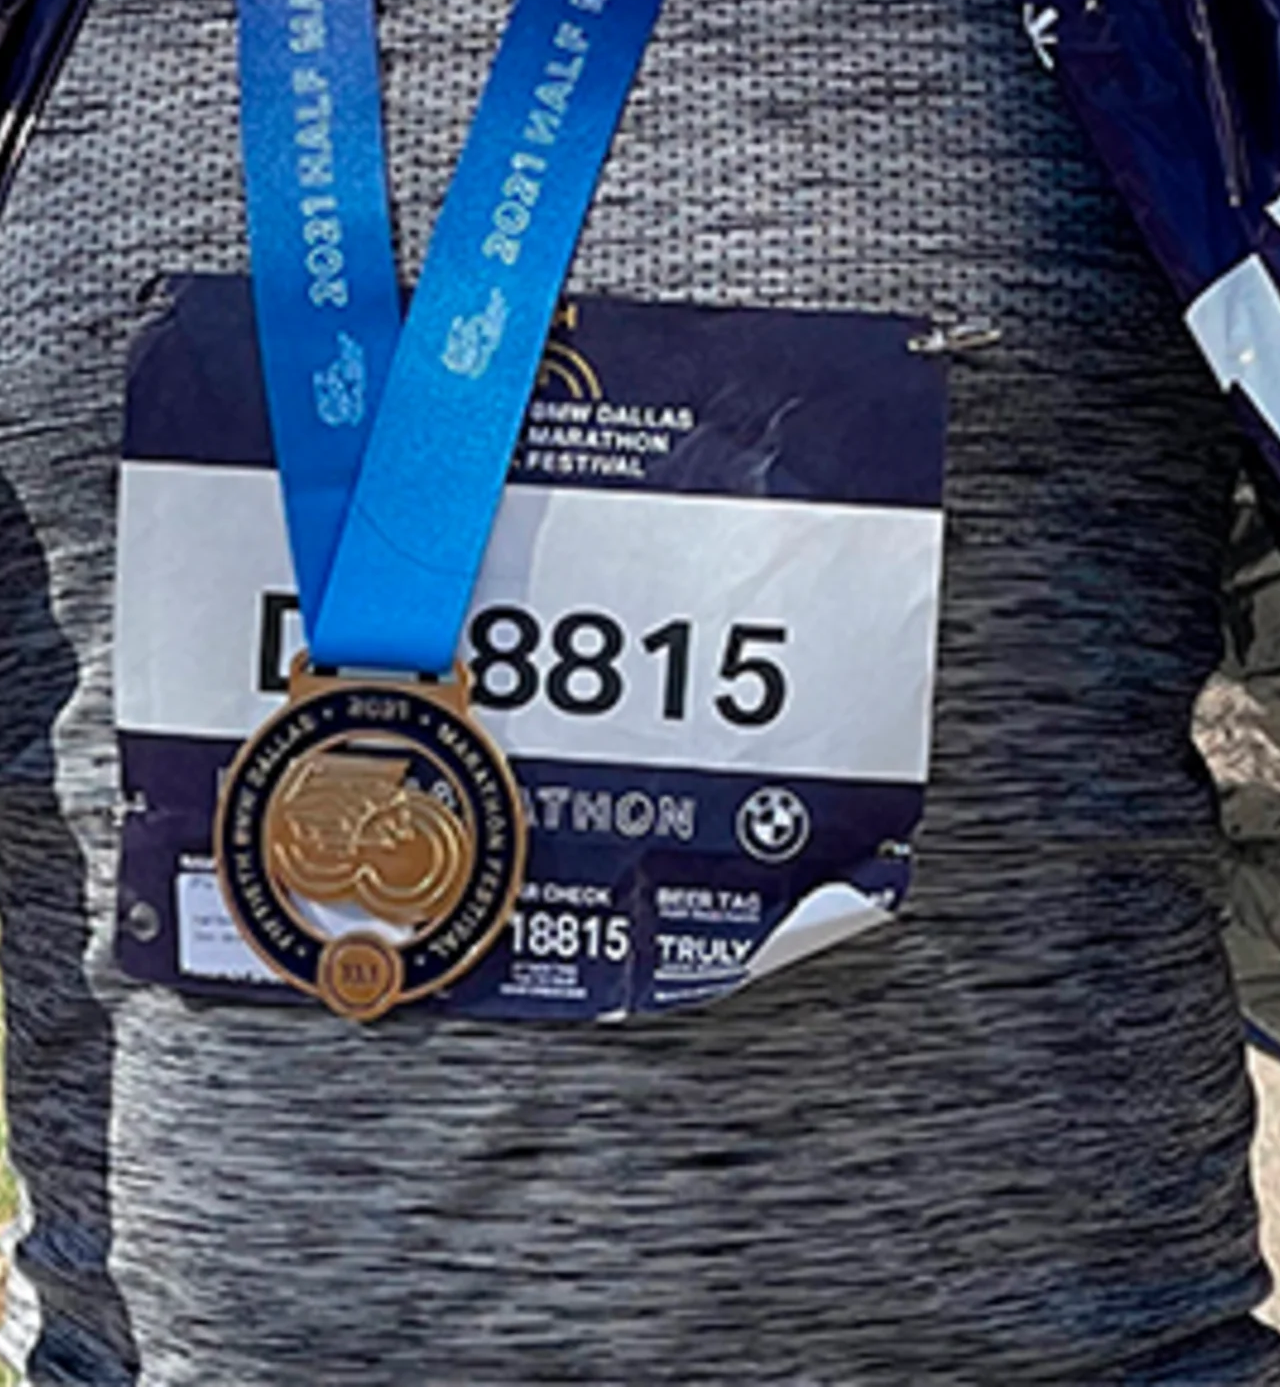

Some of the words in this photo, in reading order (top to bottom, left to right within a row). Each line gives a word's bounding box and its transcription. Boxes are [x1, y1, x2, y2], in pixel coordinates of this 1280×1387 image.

[292, 67, 335, 188] HALF
[481, 151, 548, 266] 2021
[523, 22, 590, 146] HALF
[300, 193, 349, 310] 2021
[596, 404, 695, 431] DALLAS
[527, 425, 670, 454] MARATHON
[525, 449, 648, 479] FESTIVAL
[543, 883, 612, 908] CHECK
[508, 911, 631, 962] 18815
[654, 934, 753, 966] TRULY
